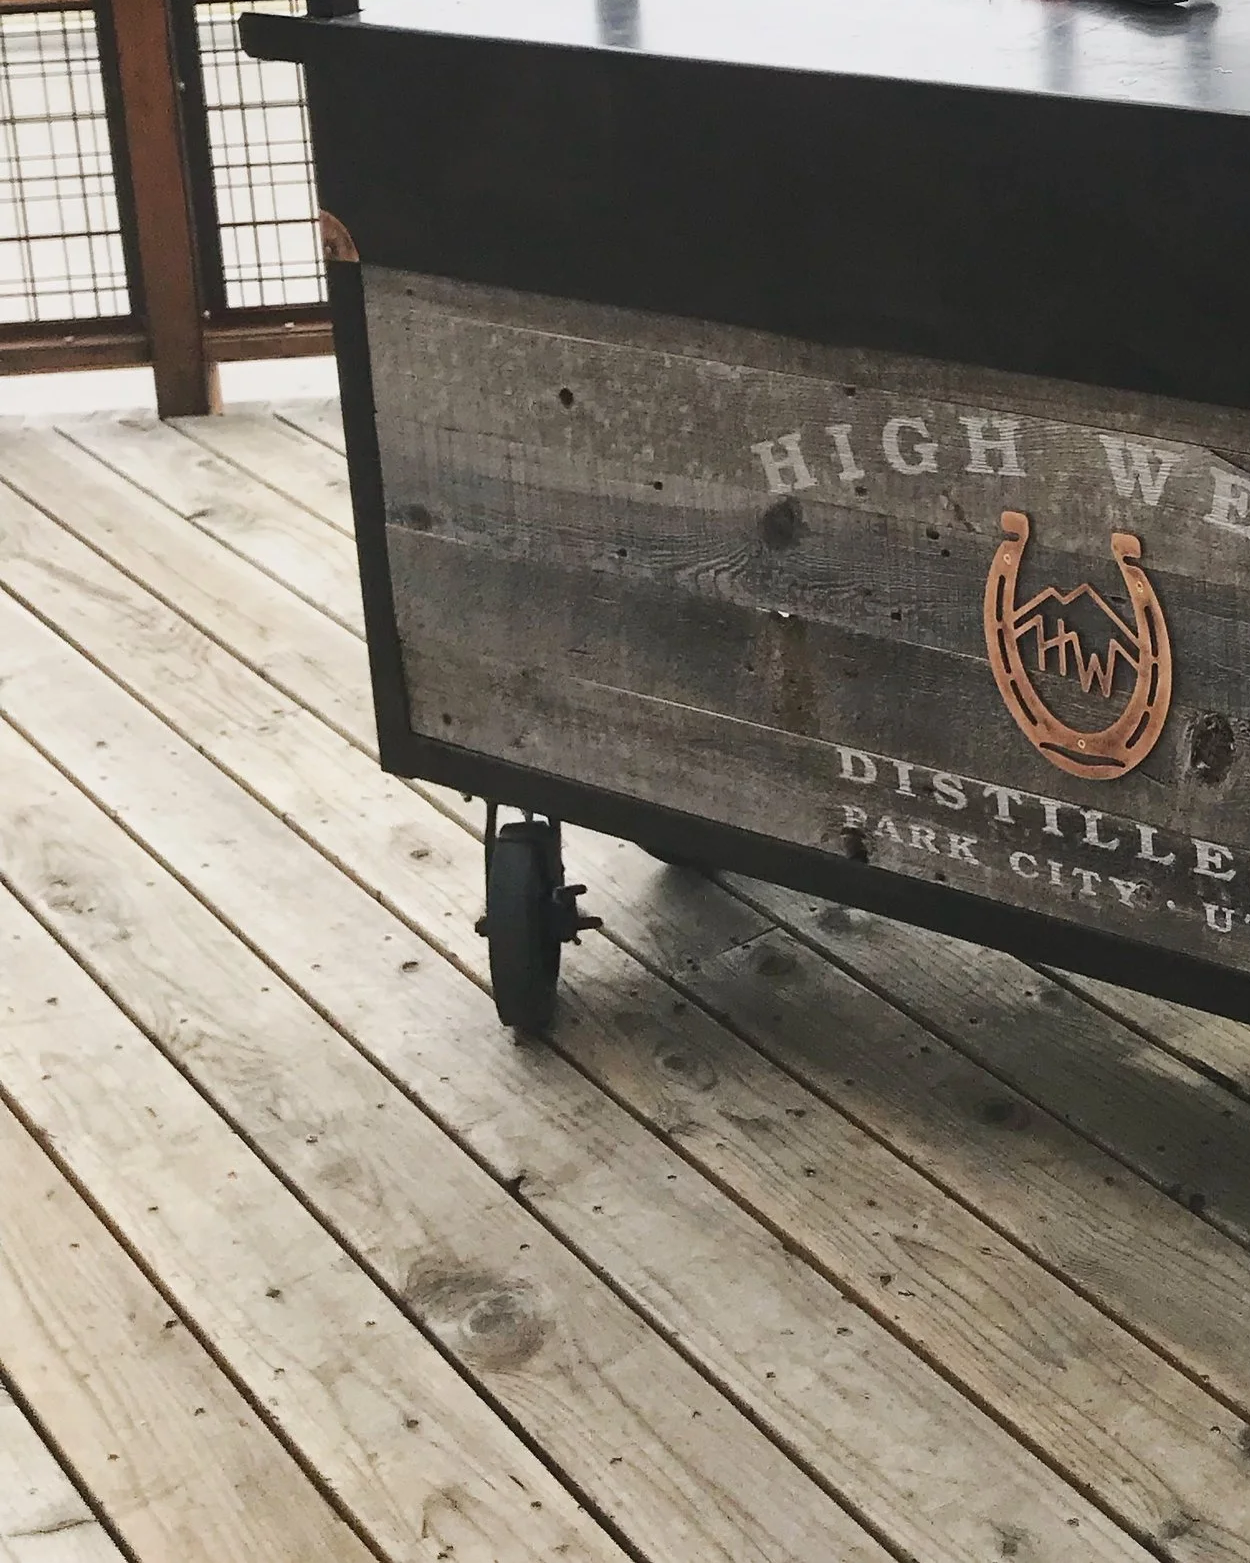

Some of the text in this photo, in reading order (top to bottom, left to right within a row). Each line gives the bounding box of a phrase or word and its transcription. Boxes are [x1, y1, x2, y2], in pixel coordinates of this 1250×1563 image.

[751, 416, 1027, 494] HIGH
[841, 804, 980, 866] PARK
[1009, 851, 1144, 908] CITY
